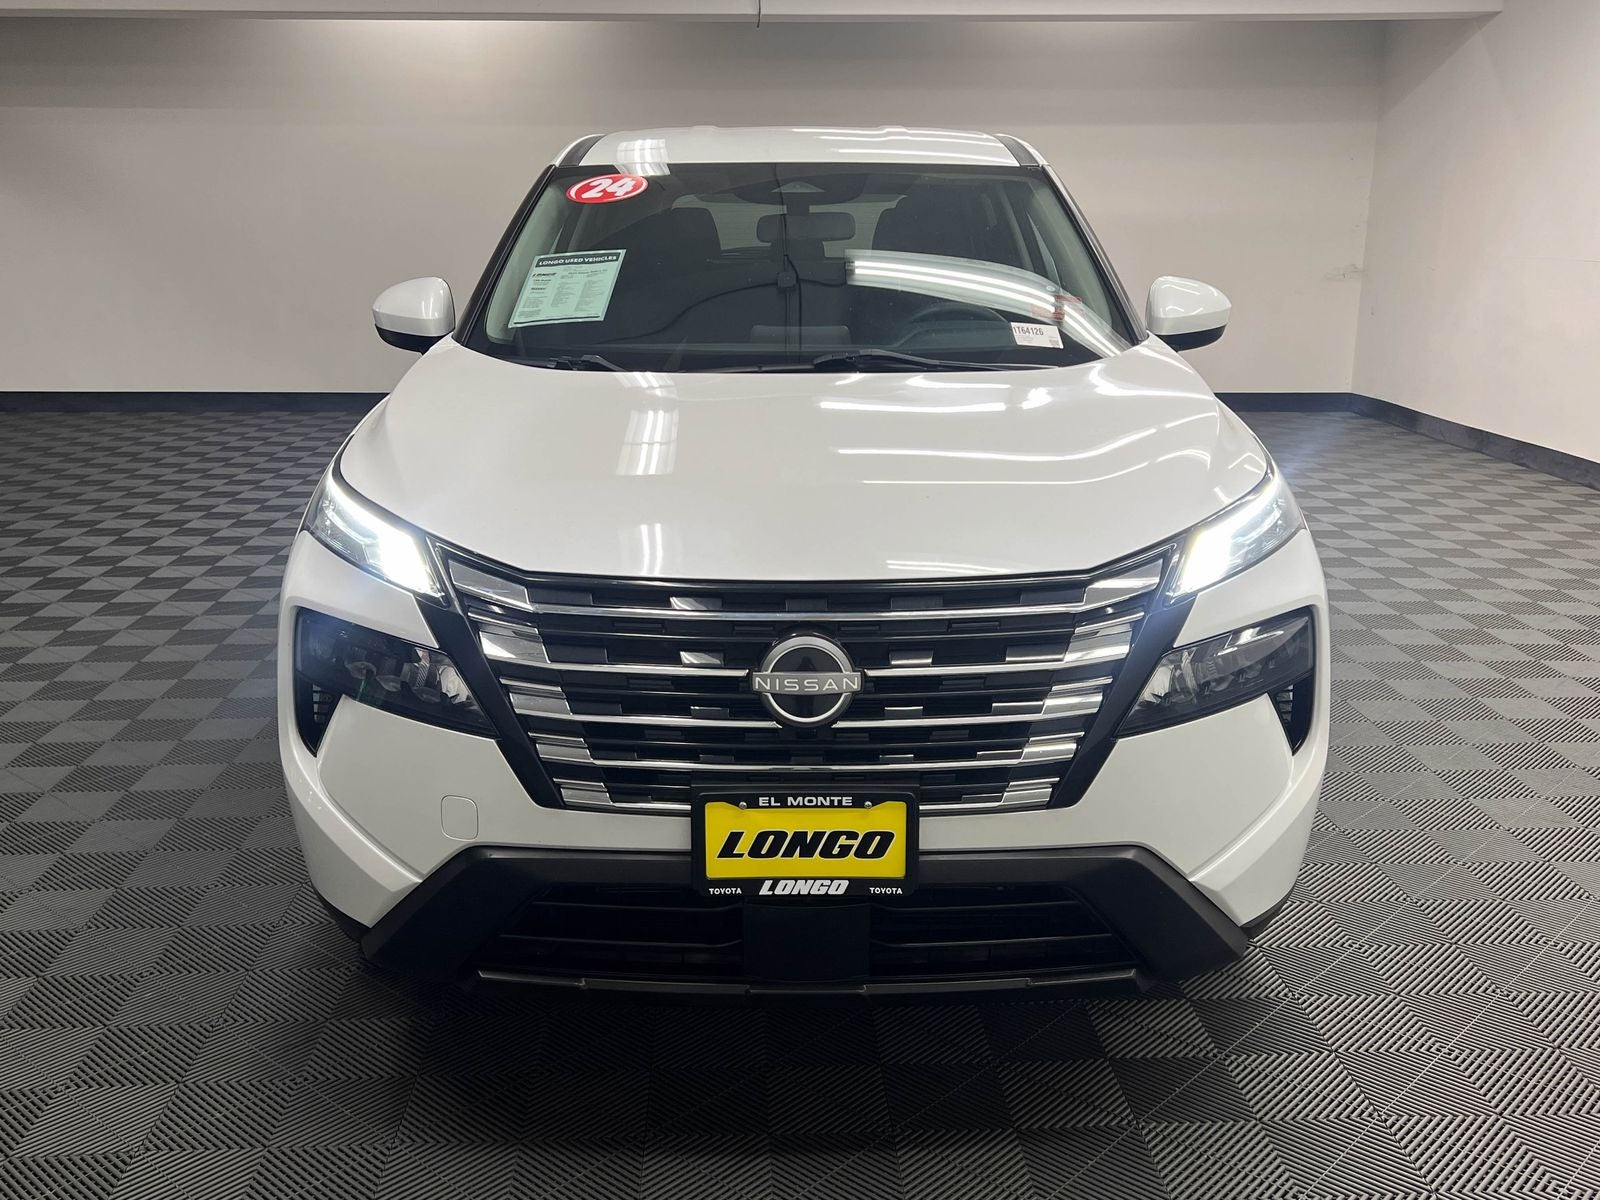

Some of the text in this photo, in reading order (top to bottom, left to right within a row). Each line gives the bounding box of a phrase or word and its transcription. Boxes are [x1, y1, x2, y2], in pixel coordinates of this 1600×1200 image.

[581, 178, 636, 199] 24
[755, 677, 858, 691] NISSAN
[759, 796, 853, 806] EL MONTE
[716, 829, 896, 860] LONGO
[708, 887, 742, 895] TOYOTA
[758, 879, 850, 896] LONGO
[869, 887, 903, 895] TOYOTA
